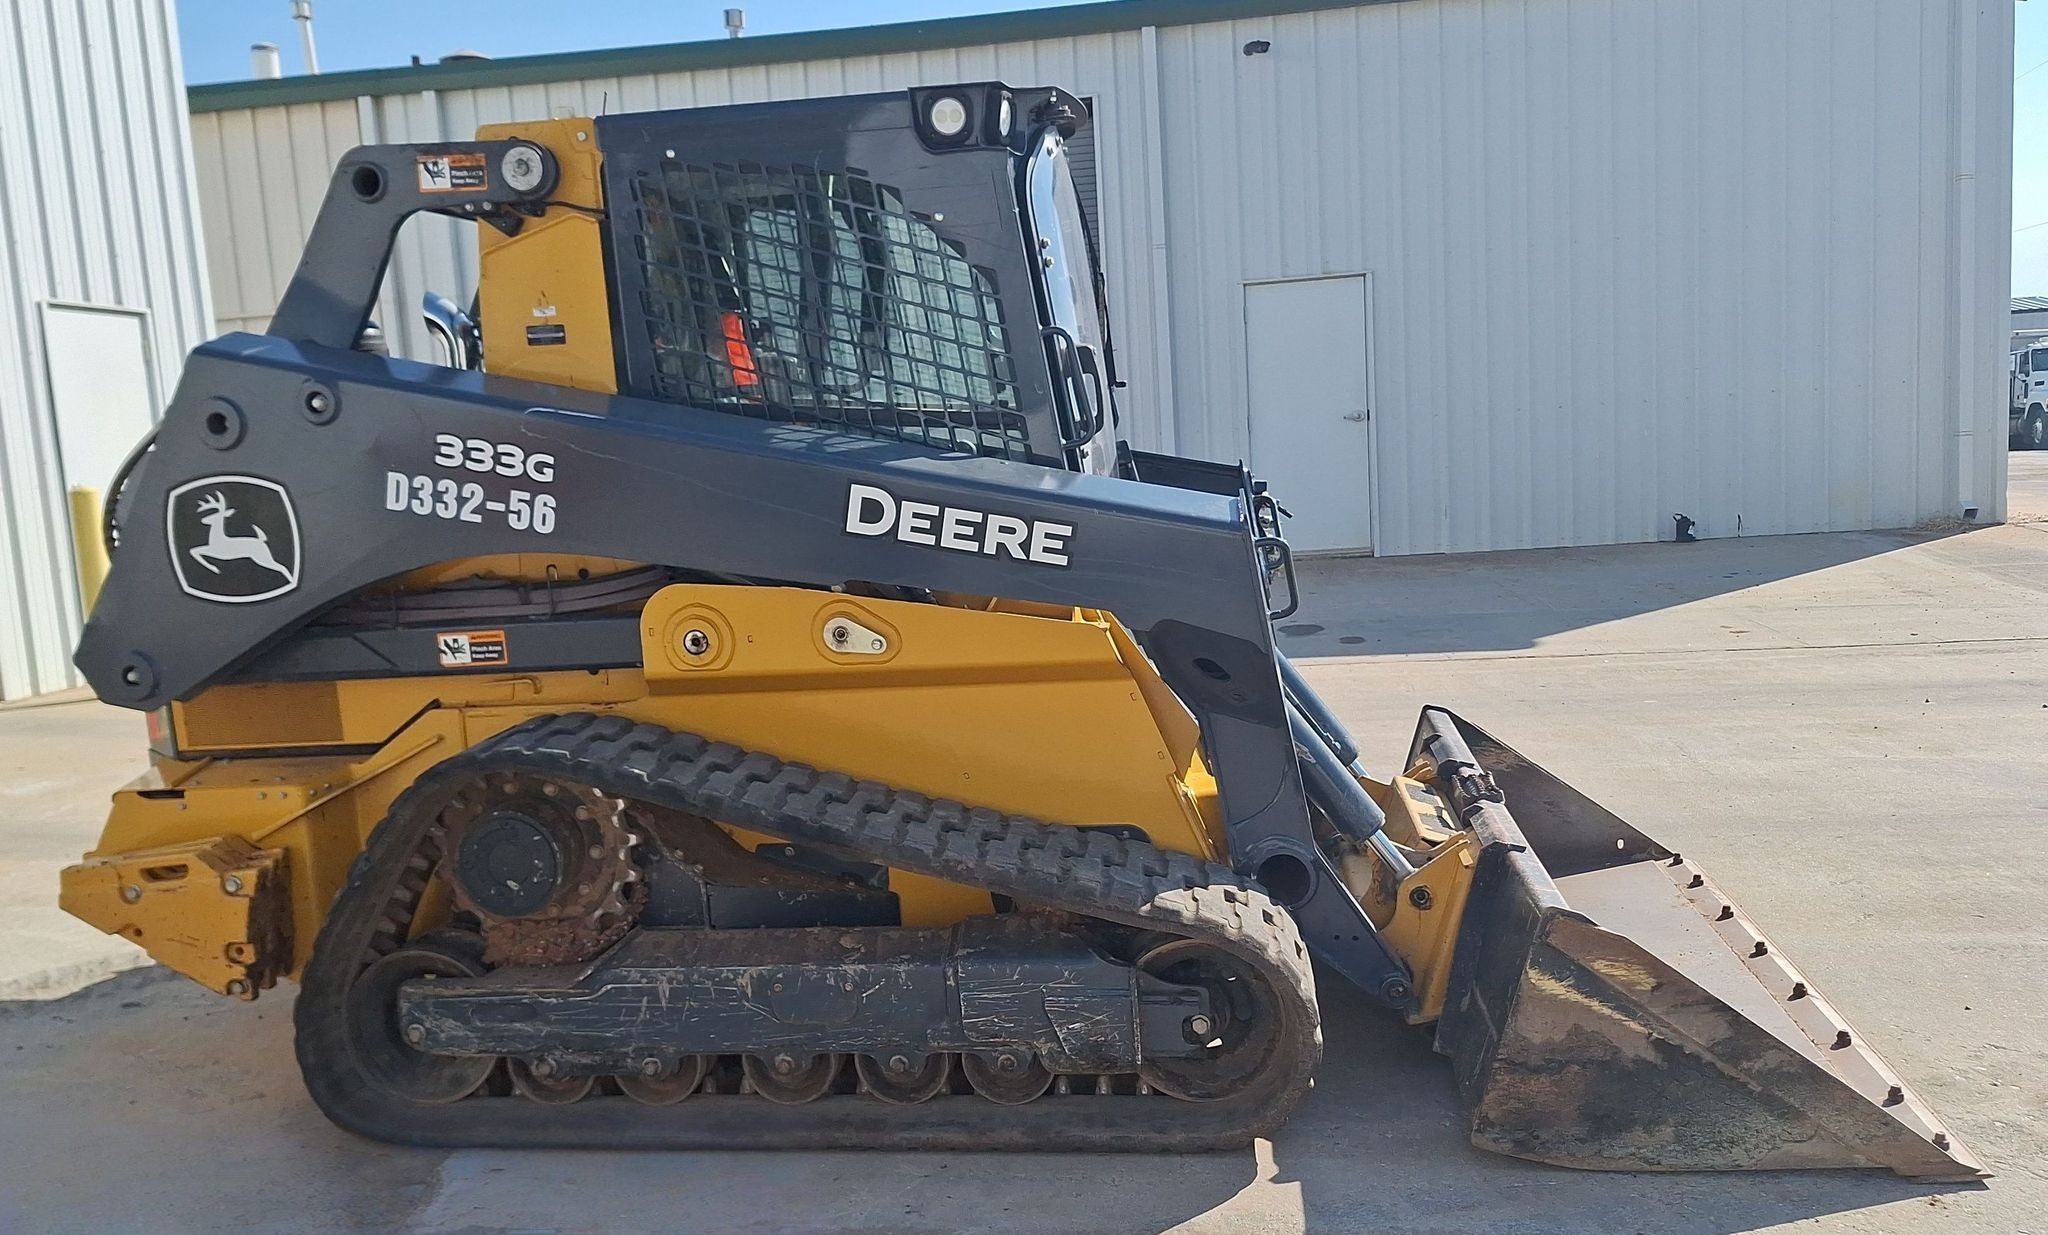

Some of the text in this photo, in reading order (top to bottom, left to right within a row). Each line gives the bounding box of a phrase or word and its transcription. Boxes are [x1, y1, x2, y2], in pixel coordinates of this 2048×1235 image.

[435, 434, 555, 482] 333G
[386, 471, 557, 534] D332-56
[846, 484, 1073, 566] DEERE
